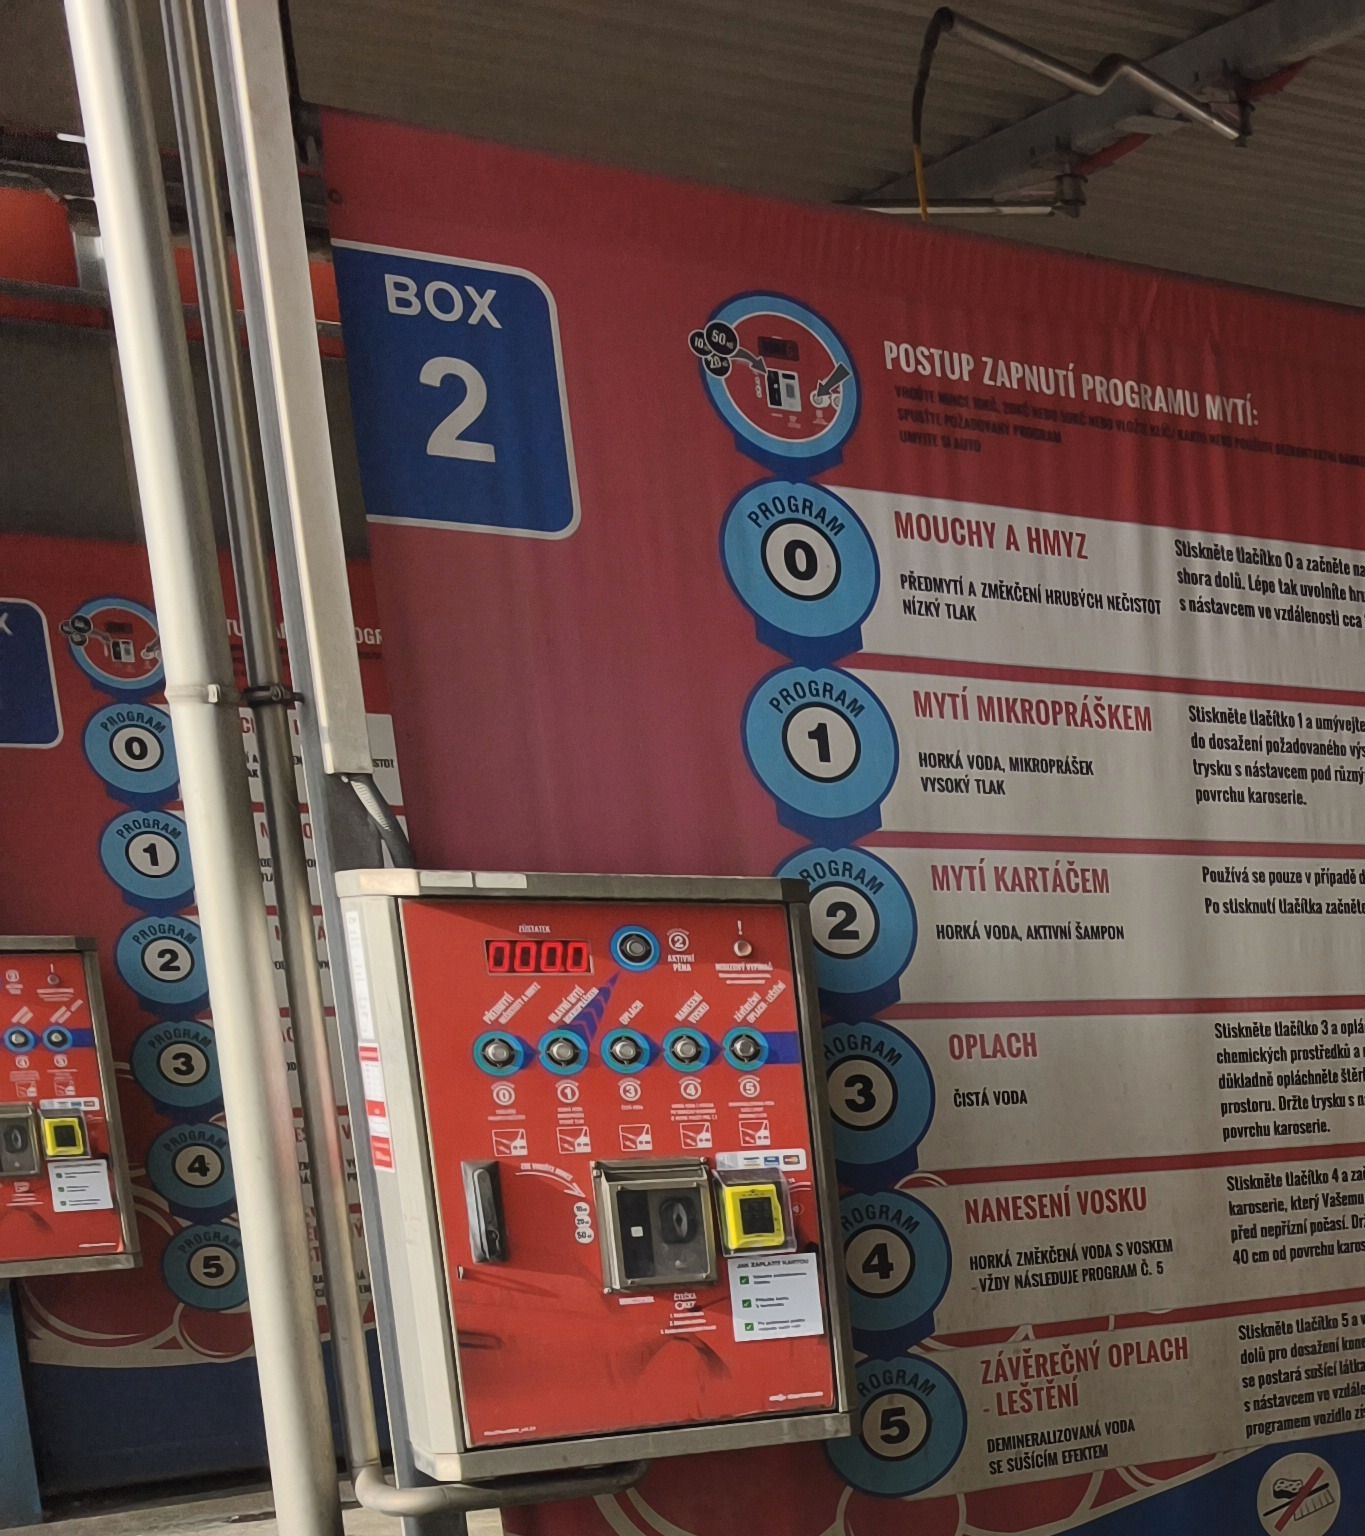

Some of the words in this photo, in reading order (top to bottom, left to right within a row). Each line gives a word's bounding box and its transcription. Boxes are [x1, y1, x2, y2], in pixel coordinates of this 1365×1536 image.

[384, 274, 502, 329] BOX
[883, 339, 974, 382] POSTUP
[980, 355, 1075, 398] ZAPNUTÍ
[1080, 372, 1199, 418] PROGRAMU
[1204, 392, 1258, 426] MYTÍ:
[419, 356, 496, 463] 2
[747, 496, 845, 537] PROGRAM
[893, 510, 996, 549] MOUCHY
[1005, 523, 1020, 552] A
[1026, 525, 1088, 560] HMYZ
[784, 539, 818, 581] 0
[1173, 538, 1234, 562] Stiskněte
[1234, 545, 1282, 568] tlačítko
[1284, 550, 1294, 569] 0
[1295, 556, 1304, 570] a
[1305, 554, 1351, 576] začněte
[899, 570, 964, 596] PŘEDMYTÍ
[967, 580, 977, 597] A
[979, 578, 1042, 604] ZMĚKČENÍ
[1044, 587, 1103, 610] HRUBÝCH
[1105, 591, 1161, 615] NEČISTOT
[902, 595, 940, 618] NÍZKÝ
[943, 602, 977, 622] TLAK
[769, 680, 866, 719] PROGRAM
[912, 689, 969, 720] MYTÍ
[976, 694, 1152, 732] MIKROPRÁŠKEM
[100, 711, 166, 734] PROGRAM
[124, 736, 148, 761] 0
[808, 722, 831, 763] 1
[917, 749, 964, 770] HORKÁ
[965, 753, 1005, 773] VODA,
[1008, 754, 1094, 776] MIKROPRÁŠEK
[919, 776, 970, 794] VYSOKÝ
[973, 778, 1006, 795] TLAK
[1194, 785, 1245, 805] povrchu
[1246, 785, 1307, 805] karoserie.
[116, 818, 182, 840] PROGRAM
[142, 843, 160, 867] 1
[798, 860, 885, 895] ROGRAM
[930, 864, 986, 892] MYTÍ
[992, 865, 1109, 894] KARTÁČEM
[1201, 865, 1250, 883] Používá
[1250, 870, 1266, 883] se
[1268, 870, 1303, 886] pouze
[1304, 870, 1311, 884] v
[1313, 866, 1357, 888] případě
[132, 924, 198, 945] PROGRAM
[826, 901, 860, 940] 2
[935, 919, 981, 940] HORKÁ
[982, 924, 1022, 942] VODA,
[1025, 920, 1072, 940] AKTIVNÍ
[1074, 920, 1124, 940] ŠAMPON
[157, 949, 181, 972] 2
[148, 1028, 212, 1049] PROGRAM
[823, 1034, 903, 1066] ROGRAM
[948, 1031, 1037, 1060] OPLACH
[171, 1052, 195, 1076] 3
[844, 1073, 877, 1113] 3
[952, 1086, 990, 1108] ČISTÁ
[992, 1088, 1028, 1106] VODA
[1222, 1120, 1270, 1142] povrchu
[1272, 1117, 1330, 1136] karoserie.
[187, 1154, 210, 1177] 4
[840, 1204, 920, 1235] ROGRAM
[964, 1183, 1070, 1224] NANESENÍ
[1076, 1185, 1147, 1215] VOSKU
[202, 1255, 225, 1279] 5
[862, 1243, 894, 1280] 4
[968, 1248, 1012, 1271] HORKÁ
[1015, 1242, 1079, 1266] ZMĚKČENÁ
[1080, 1242, 1112, 1261] VODA
[1114, 1241, 1124, 1257] S
[1124, 1237, 1173, 1256] VOSKEM
[1232, 1247, 1249, 1265] 40
[1250, 1250, 1270, 1263] cm
[1271, 1244, 1287, 1261] od
[1288, 1240, 1335, 1262] povrchu
[978, 1272, 1010, 1292] VŽDY
[1013, 1268, 1079, 1289] NÁSLEDUJE
[1081, 1262, 1137, 1282] PROGRAM
[1140, 1258, 1153, 1276] Č.
[1155, 1260, 1164, 1275] 5
[979, 1338, 1100, 1385] ZÁVĚREČNÝ
[1107, 1335, 1188, 1368] OPLACH
[856, 1369, 937, 1397] ROGRAM
[995, 1381, 1079, 1416] LEŠTĚNÍ
[880, 1406, 910, 1445] 5
[986, 1418, 1102, 1453] DEMINERALIZOVANÁ
[1103, 1418, 1135, 1435] VODA
[1245, 1415, 1311, 1439] programem
[1312, 1405, 1352, 1426] vozidlo
[988, 1458, 1004, 1475] SE
[1005, 1448, 1059, 1472] SUŠÍCÍM
[1060, 1443, 1108, 1464] EFEKTEM
